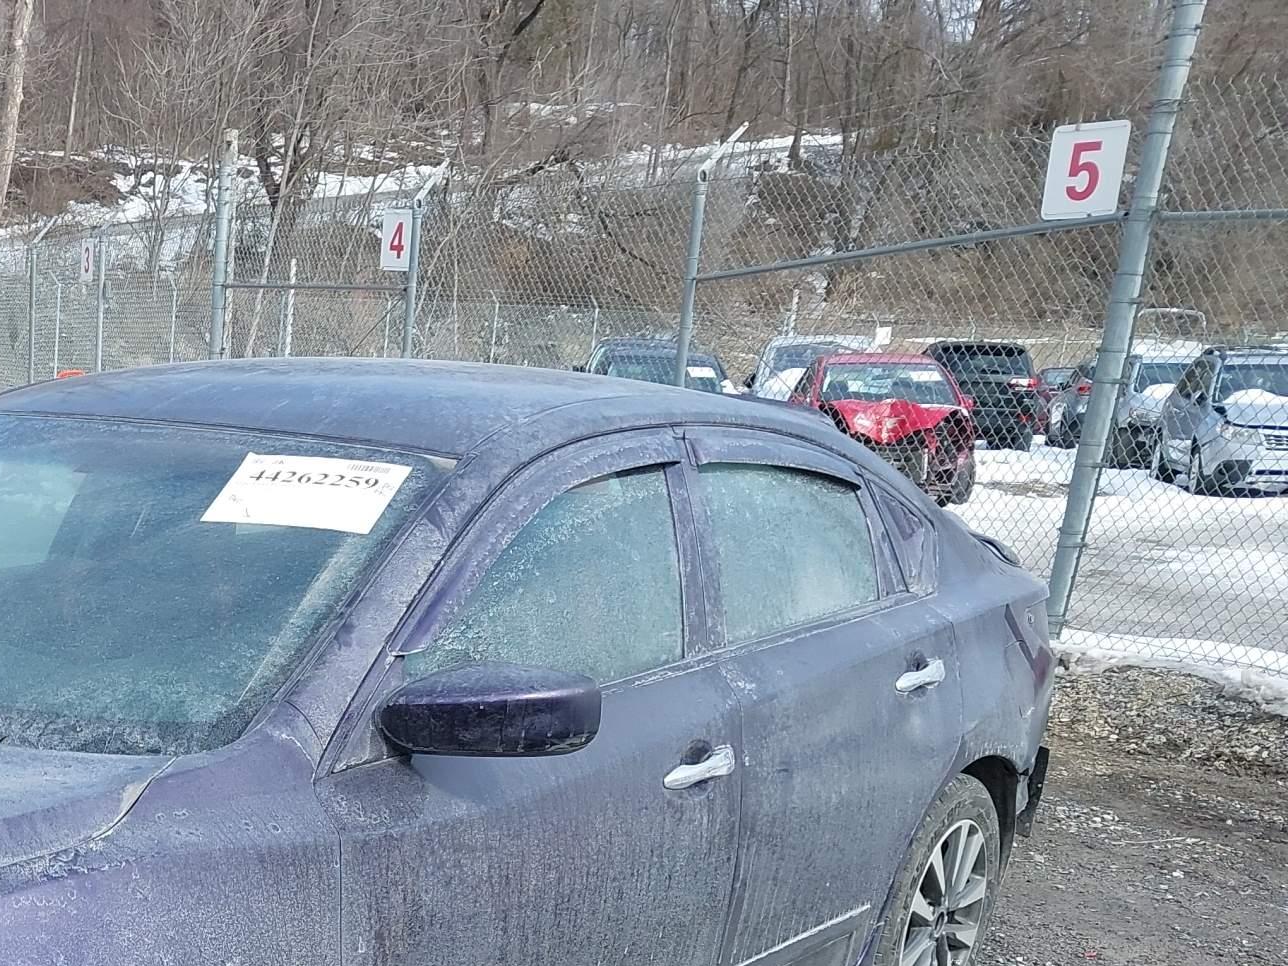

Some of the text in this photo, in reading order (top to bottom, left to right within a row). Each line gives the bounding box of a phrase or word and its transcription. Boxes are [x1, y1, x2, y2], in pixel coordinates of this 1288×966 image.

[1065, 140, 1103, 201] 5
[389, 221, 404, 259] 4
[84, 246, 90, 273] 3
[249, 469, 380, 489] 44262259
